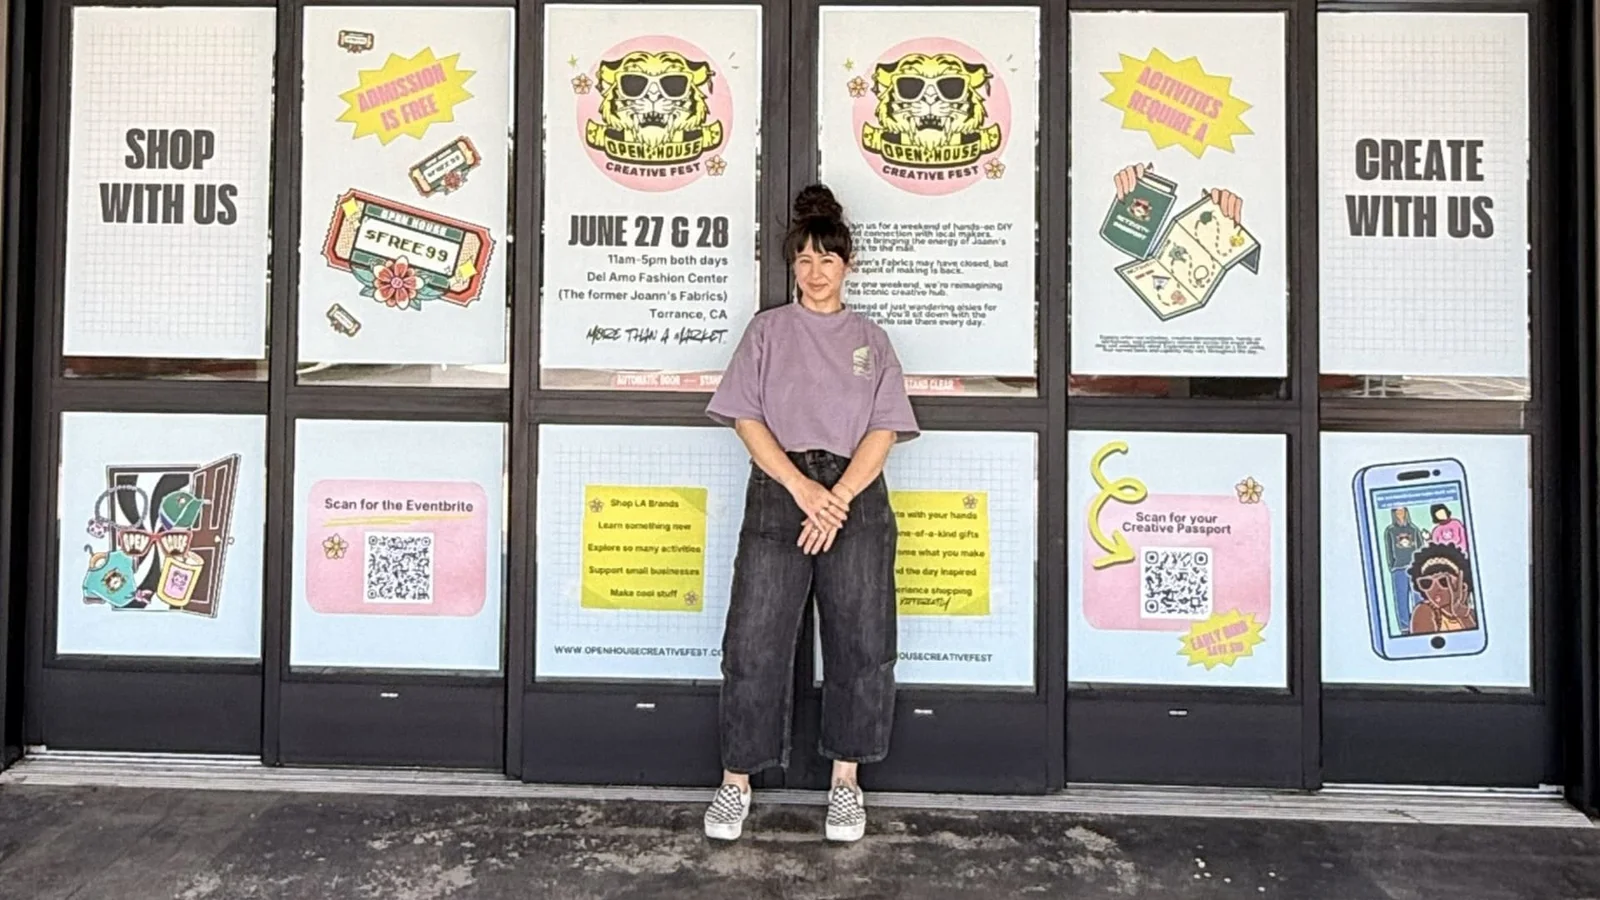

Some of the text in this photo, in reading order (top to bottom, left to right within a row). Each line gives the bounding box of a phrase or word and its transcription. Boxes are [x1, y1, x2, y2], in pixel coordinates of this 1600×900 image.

[357, 62, 447, 113] ADMISSION
[1136, 65, 1223, 120] ACTIVITIES
[380, 94, 440, 131] IS FREE
[1127, 89, 1209, 143] REQUIRE A
[125, 128, 215, 170] SHOP
[607, 141, 701, 159] OPEN HOUSE
[884, 143, 978, 162] OPEN HOUSE
[1355, 138, 1484, 181] CREATE
[605, 162, 701, 177] CREATIVE FEST
[882, 165, 979, 180] CREATIVE FEST
[100, 183, 238, 225] WITH US
[1345, 194, 1494, 239] WITH US
[568, 215, 729, 248] JUNE 27 & 28
[878, 222, 891, 230] for
[900, 222, 940, 230] weekend
[942, 222, 951, 230] of
[997, 222, 1013, 231] DIY
[873, 237, 909, 246] bringing
[928, 239, 958, 247] energy
[608, 254, 728, 268] 11am-5pm both days
[916, 260, 934, 268] may
[885, 266, 895, 274] of
[896, 267, 928, 276] making
[587, 272, 728, 283] Del Amo Fashion Center
[950, 282, 1003, 291] reimagining
[558, 289, 728, 302] (The former Joann's Fabrics)
[879, 302, 888, 310] of
[890, 302, 906, 311] just
[908, 303, 955, 312] wandering
[984, 303, 997, 311] for
[649, 309, 728, 321] Torrance, CA
[939, 319, 964, 328] every
[586, 324, 622, 345] MORE
[625, 327, 658, 343] THAN
[660, 327, 670, 344] A
[325, 498, 474, 512] Scan for the Eventbrite
[610, 498, 631, 508] Shop
[649, 500, 679, 508] Brands
[907, 510, 926, 518] with
[928, 512, 948, 520] your
[950, 511, 977, 519] hands
[1136, 512, 1218, 525] Scan for your
[598, 521, 623, 530] Learn
[625, 521, 671, 532] something
[1122, 522, 1231, 536] Creative Passport
[897, 529, 979, 540] ne-of-a-kind gifts
[588, 543, 621, 553] Explore
[635, 545, 659, 554] many
[661, 544, 701, 553] activities
[897, 548, 985, 558] ome what you make
[589, 565, 700, 576] Support small businesses
[905, 567, 920, 575] the
[922, 567, 938, 577] day
[940, 567, 977, 577] inspired
[610, 588, 678, 598] Make cool stuff
[931, 587, 972, 597] shopping
[554, 645, 722, 657] WWW.OPENHOUSECREATIVEFEST.CO
[898, 652, 993, 662] OUSECREATIVEFEST
